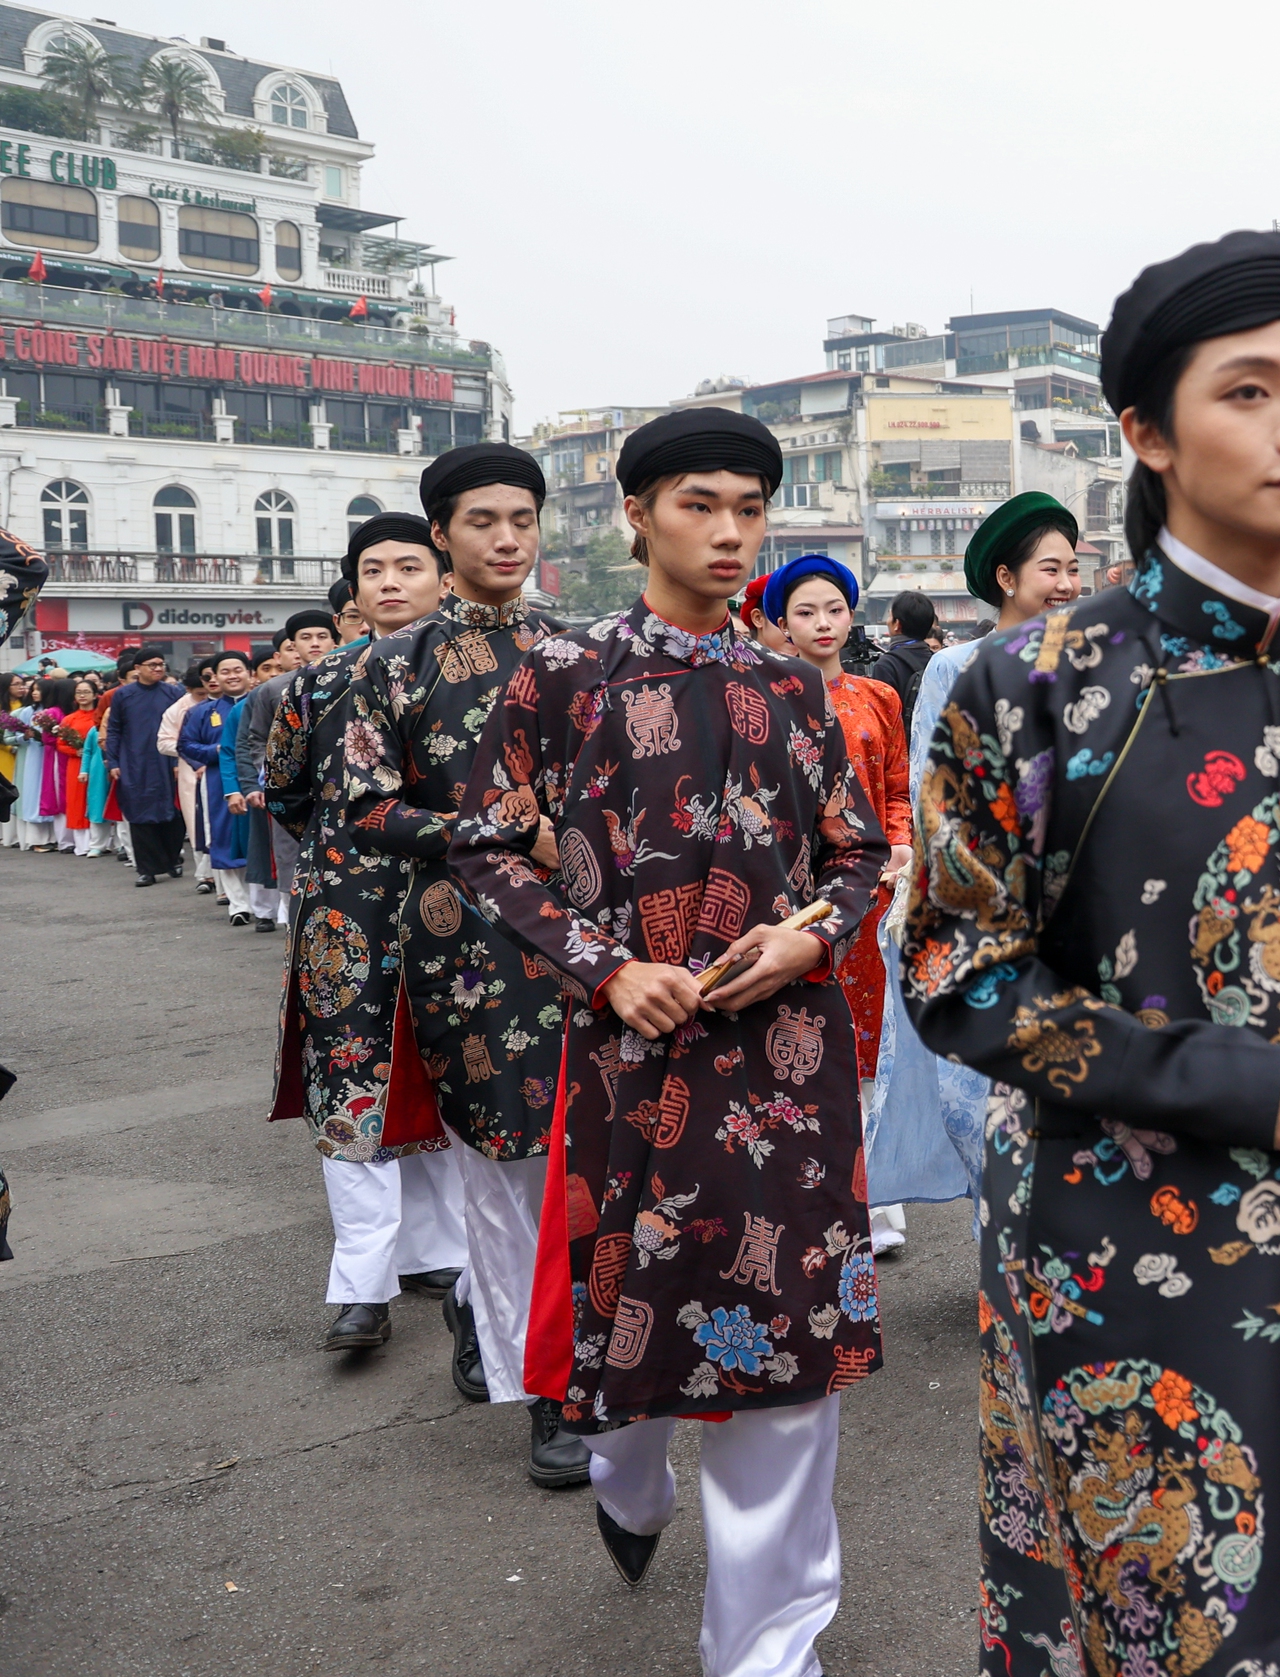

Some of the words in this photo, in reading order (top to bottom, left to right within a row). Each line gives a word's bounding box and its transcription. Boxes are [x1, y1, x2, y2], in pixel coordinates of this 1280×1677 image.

[50, 150, 118, 190] CLUB
[182, 188, 191, 203] &
[195, 190, 257, 213] Restaurant
[188, 346, 236, 381] NAM
[239, 350, 306, 387] QUANG
[311, 357, 354, 393] VINH
[911, 507, 975, 515] HERBALIST
